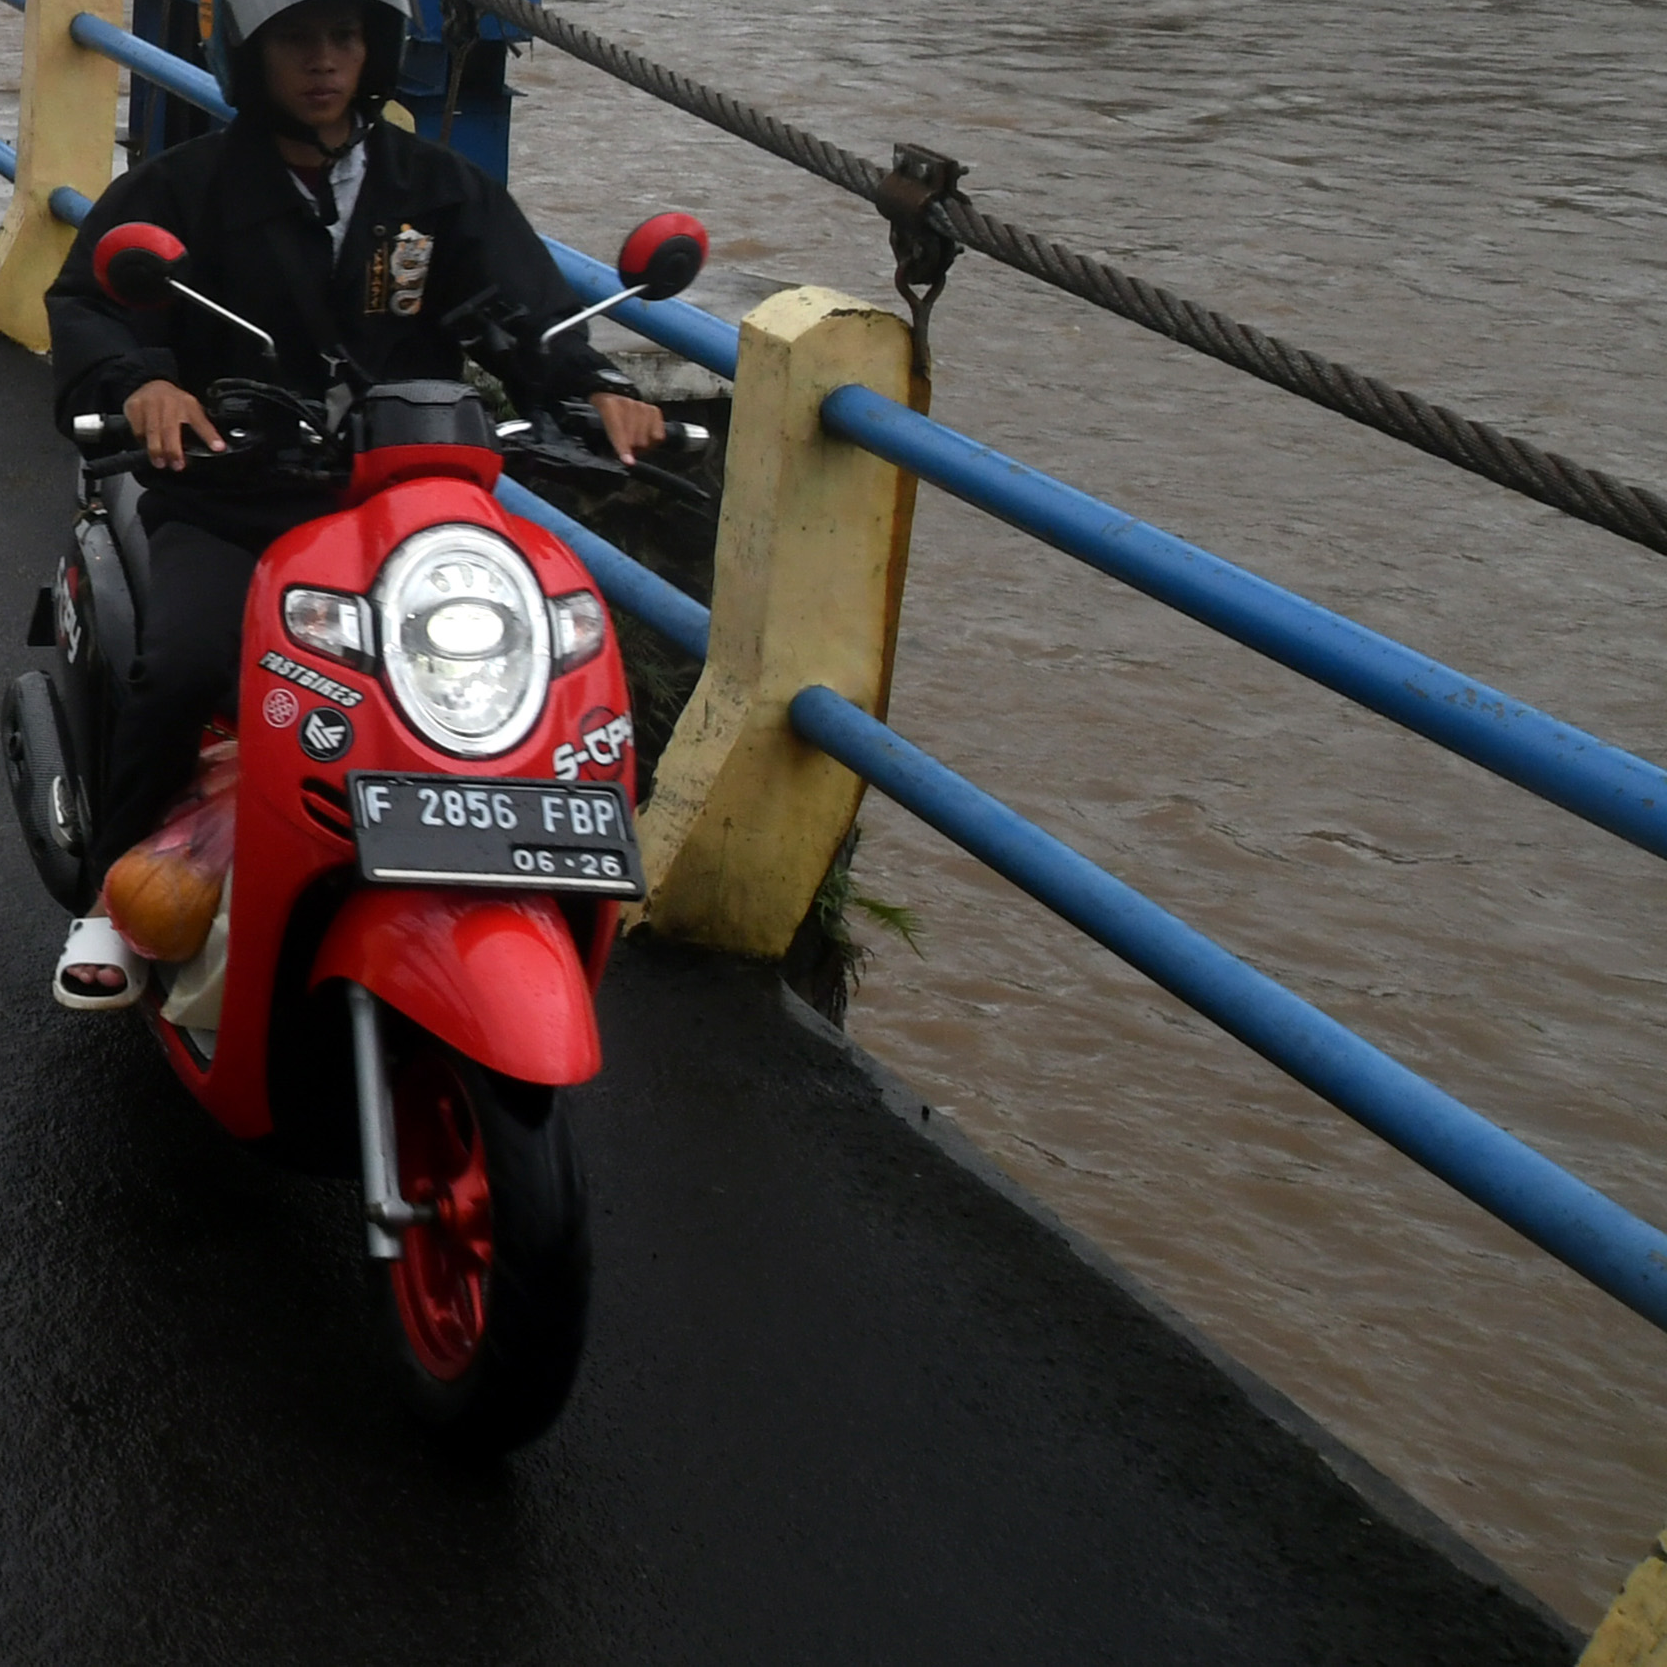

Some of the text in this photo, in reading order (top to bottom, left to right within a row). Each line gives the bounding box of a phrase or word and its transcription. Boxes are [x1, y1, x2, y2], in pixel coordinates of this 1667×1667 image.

[258, 651, 364, 707] FASTBIKES
[366, 785, 615, 836] F 2856 FBP
